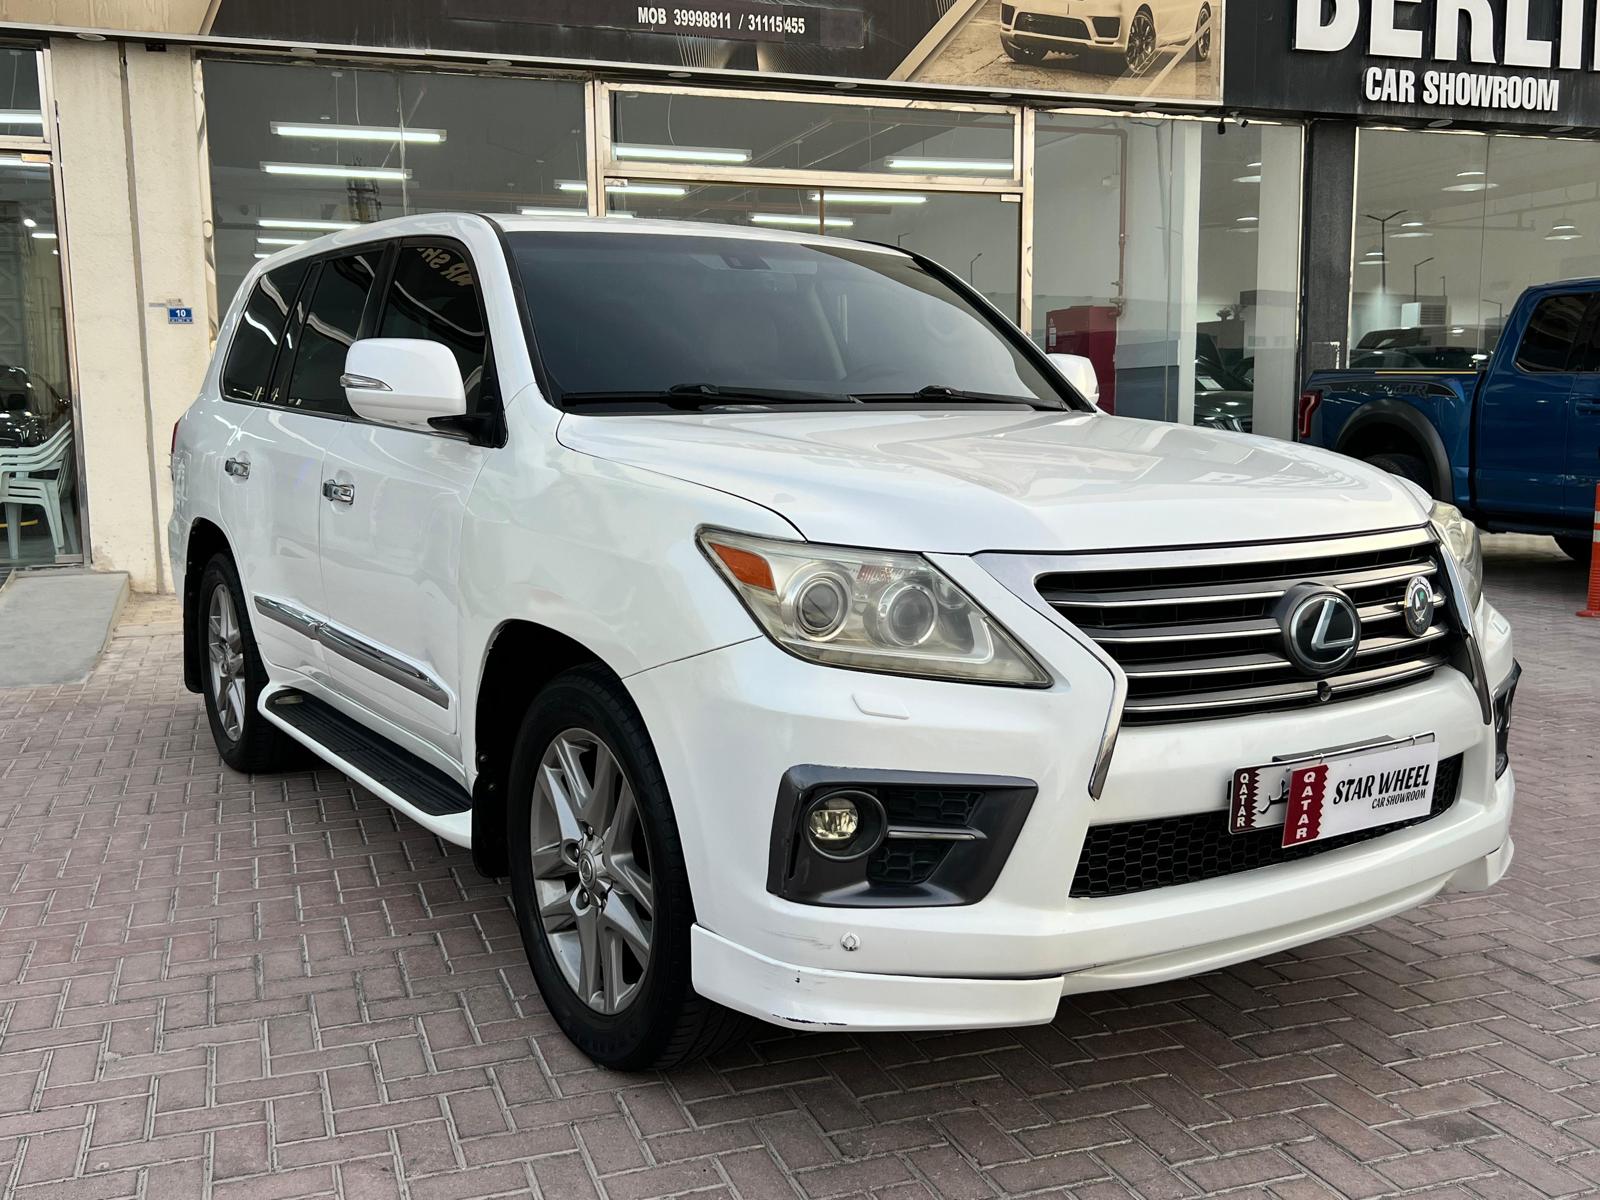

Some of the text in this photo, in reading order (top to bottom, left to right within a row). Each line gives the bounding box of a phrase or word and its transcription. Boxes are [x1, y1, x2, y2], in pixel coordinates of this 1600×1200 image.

[638, 6, 667, 25] MOB
[674, 8, 731, 30] 39998811
[748, 14, 805, 34] 31115455
[1365, 66, 1559, 112] CAR SHOWROOM
[175, 309, 187, 317] 10
[1236, 772, 1250, 828] QATAR
[1333, 763, 1431, 805] STAR WHEEL
[1371, 788, 1427, 810] CAR SHOWROOM
[1295, 771, 1317, 840] QATAR
